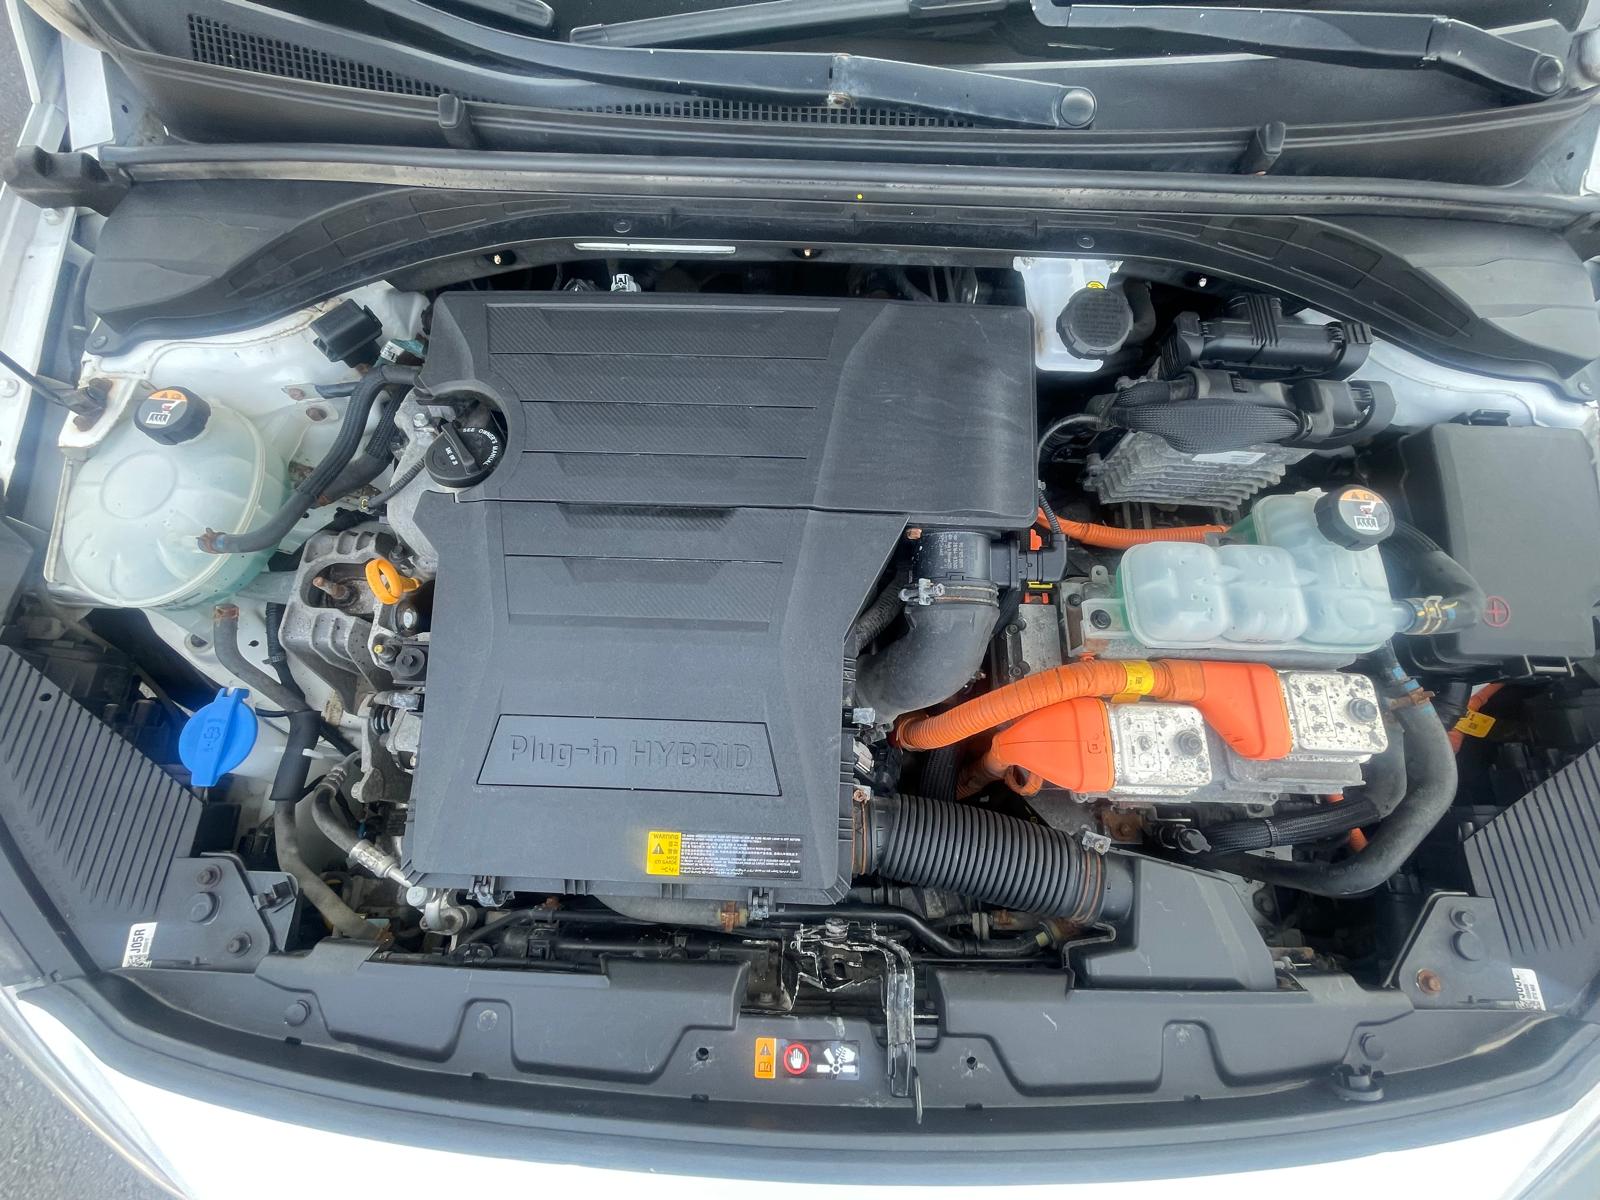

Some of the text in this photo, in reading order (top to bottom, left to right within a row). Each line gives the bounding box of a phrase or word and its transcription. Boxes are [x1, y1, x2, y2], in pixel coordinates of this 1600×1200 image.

[482, 445, 499, 466] MANUAL
[510, 734, 753, 770] Plug-in HYBRID
[130, 929, 147, 954] J05R
